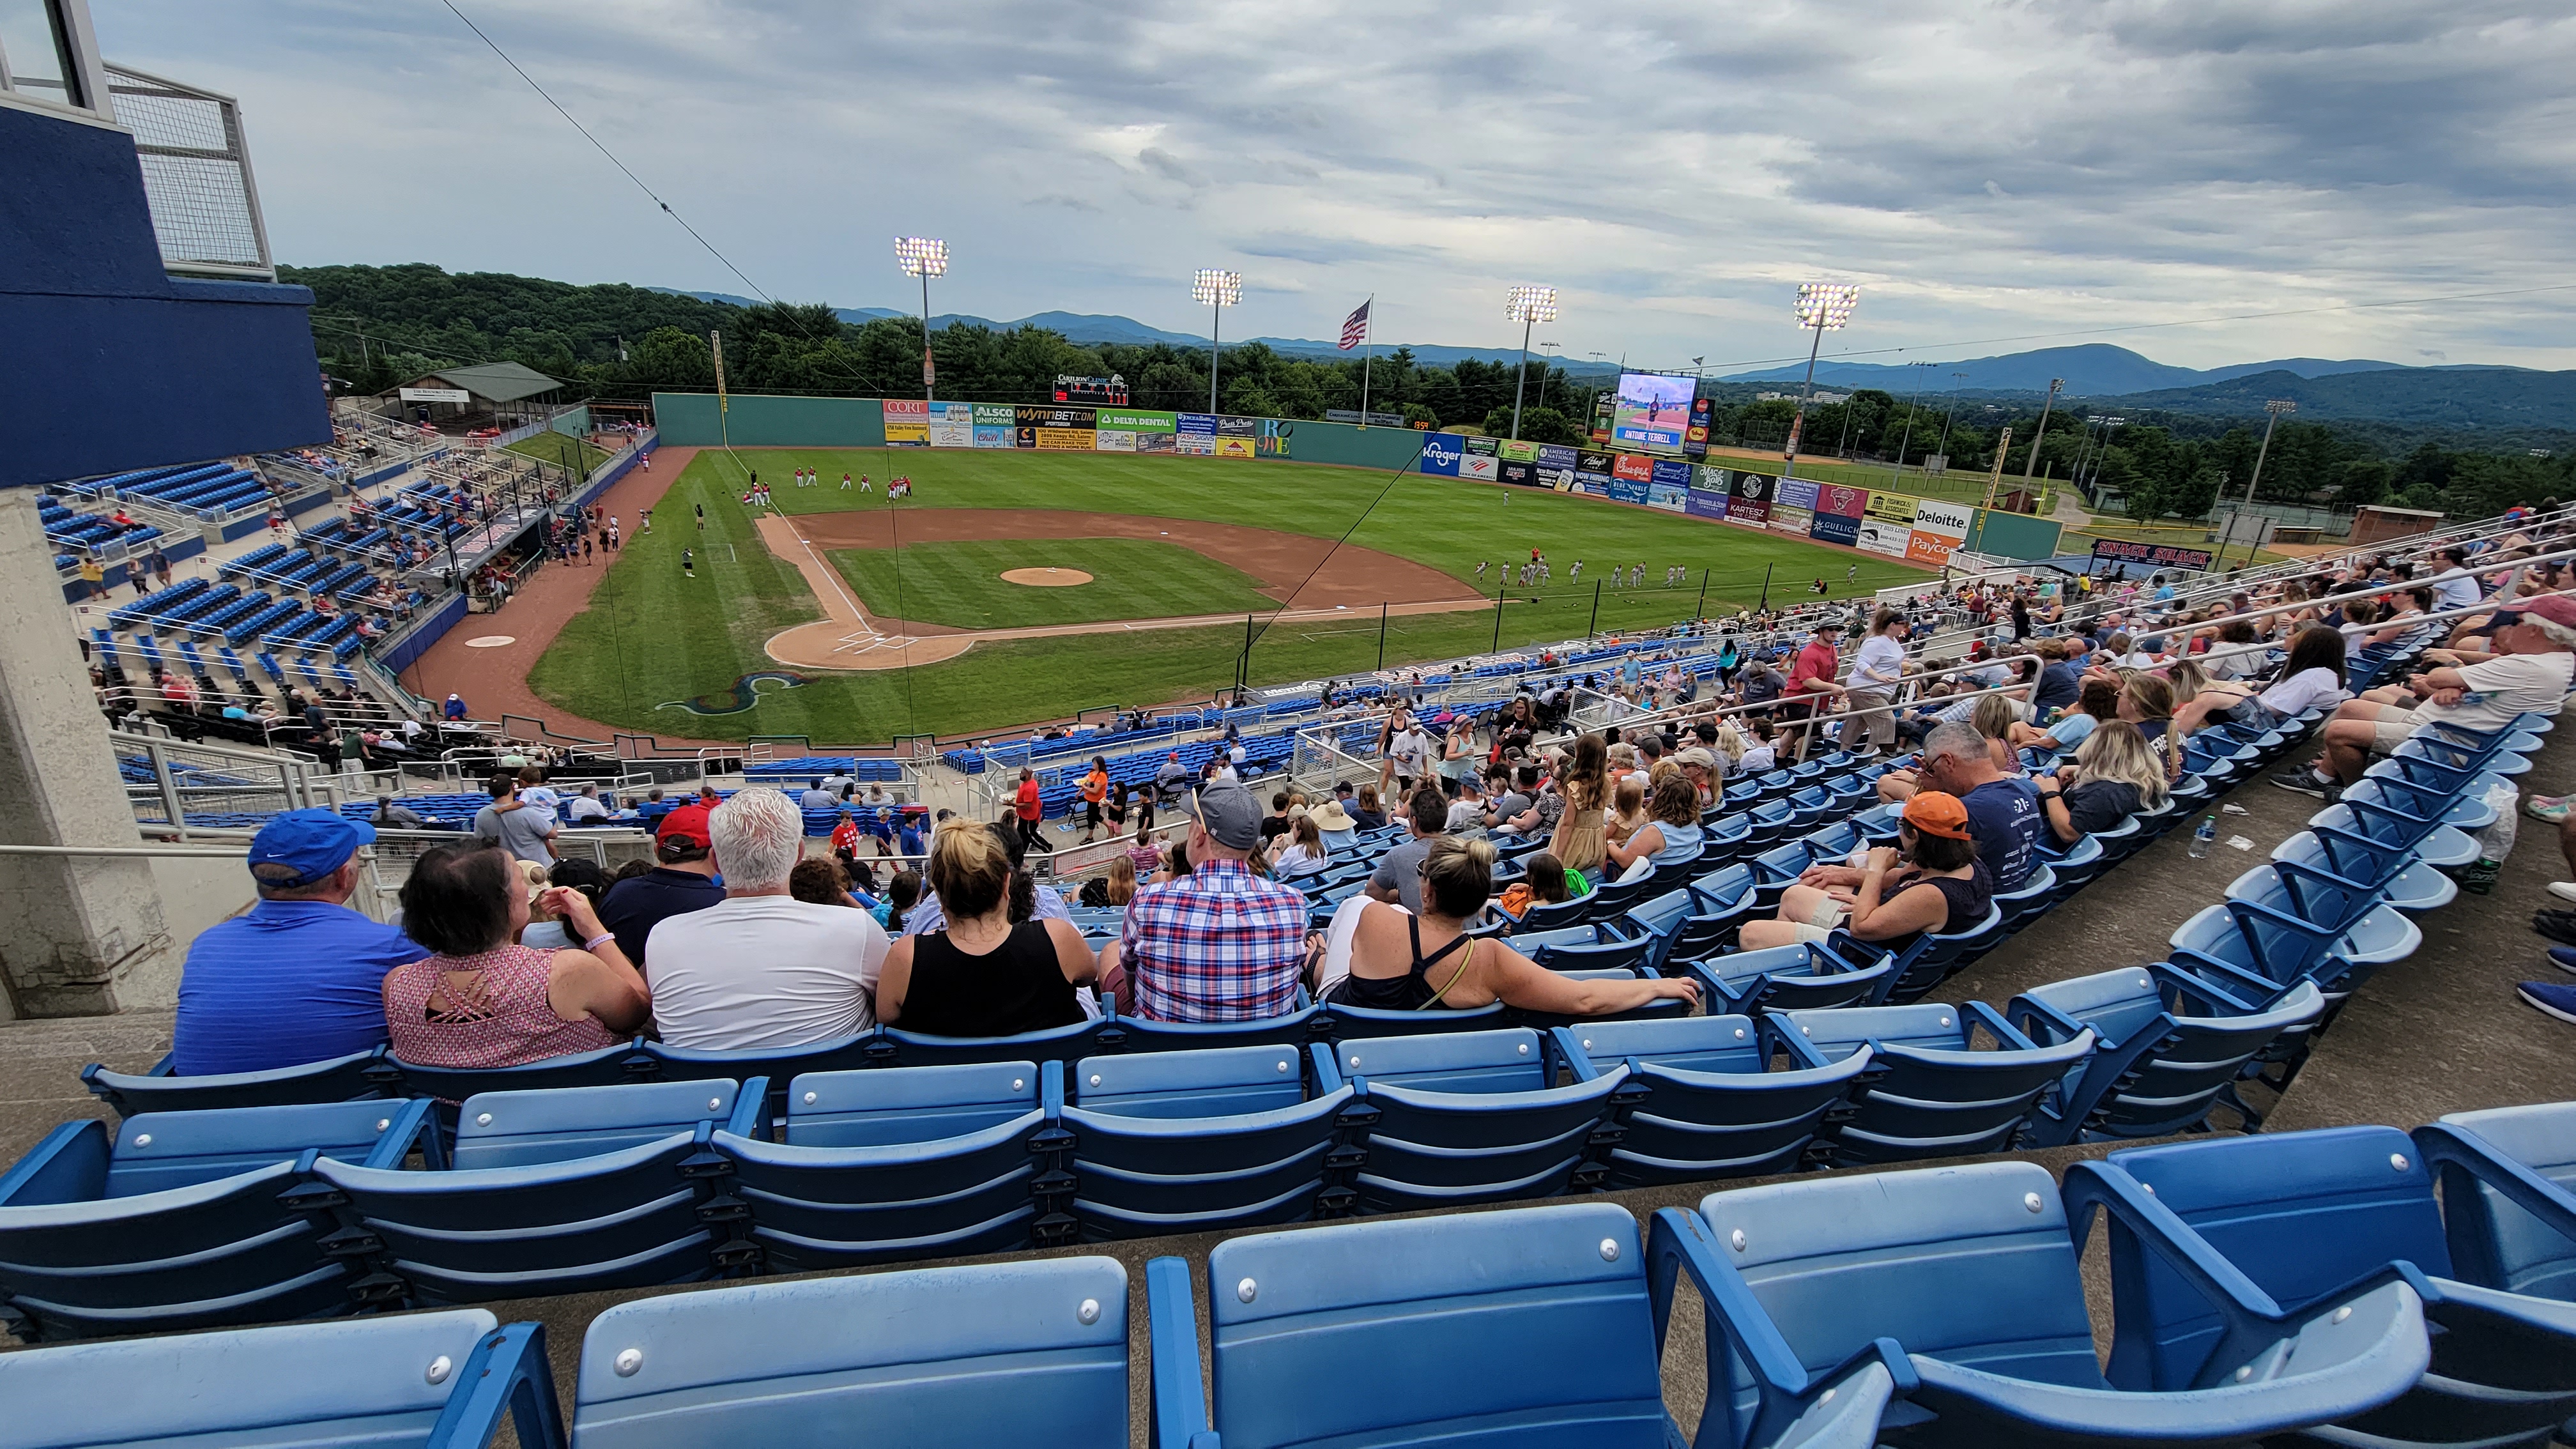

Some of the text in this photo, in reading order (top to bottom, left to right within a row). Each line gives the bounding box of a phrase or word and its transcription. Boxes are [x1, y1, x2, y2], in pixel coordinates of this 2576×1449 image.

[888, 401, 923, 413] CORT
[975, 406, 1013, 417] ALSCO
[1113, 416, 1171, 427] DELTA DENTAL
[1219, 419, 1235, 428] Press
[1236, 418, 1254, 427] Press
[977, 433, 999, 442] Chill
[1625, 430, 1671, 443] ANTOINE TERRELL
[1423, 441, 1460, 466] Kroger
[1548, 448, 1576, 457] AMERICAN
[1575, 471, 1589, 480] NOW
[1590, 473, 1609, 483] HIRING
[1887, 498, 1906, 507] FISHWICK
[1730, 504, 1765, 517] KARTESZ
[1885, 505, 1909, 514] ASSOCIATES
[1917, 509, 1966, 529] Deloitte.
[1825, 521, 1860, 535] GUELICH
[1862, 521, 1883, 530] ABBOTT
[1912, 537, 1951, 555] Payco
[2096, 541, 2210, 565] SNACK SHACK
